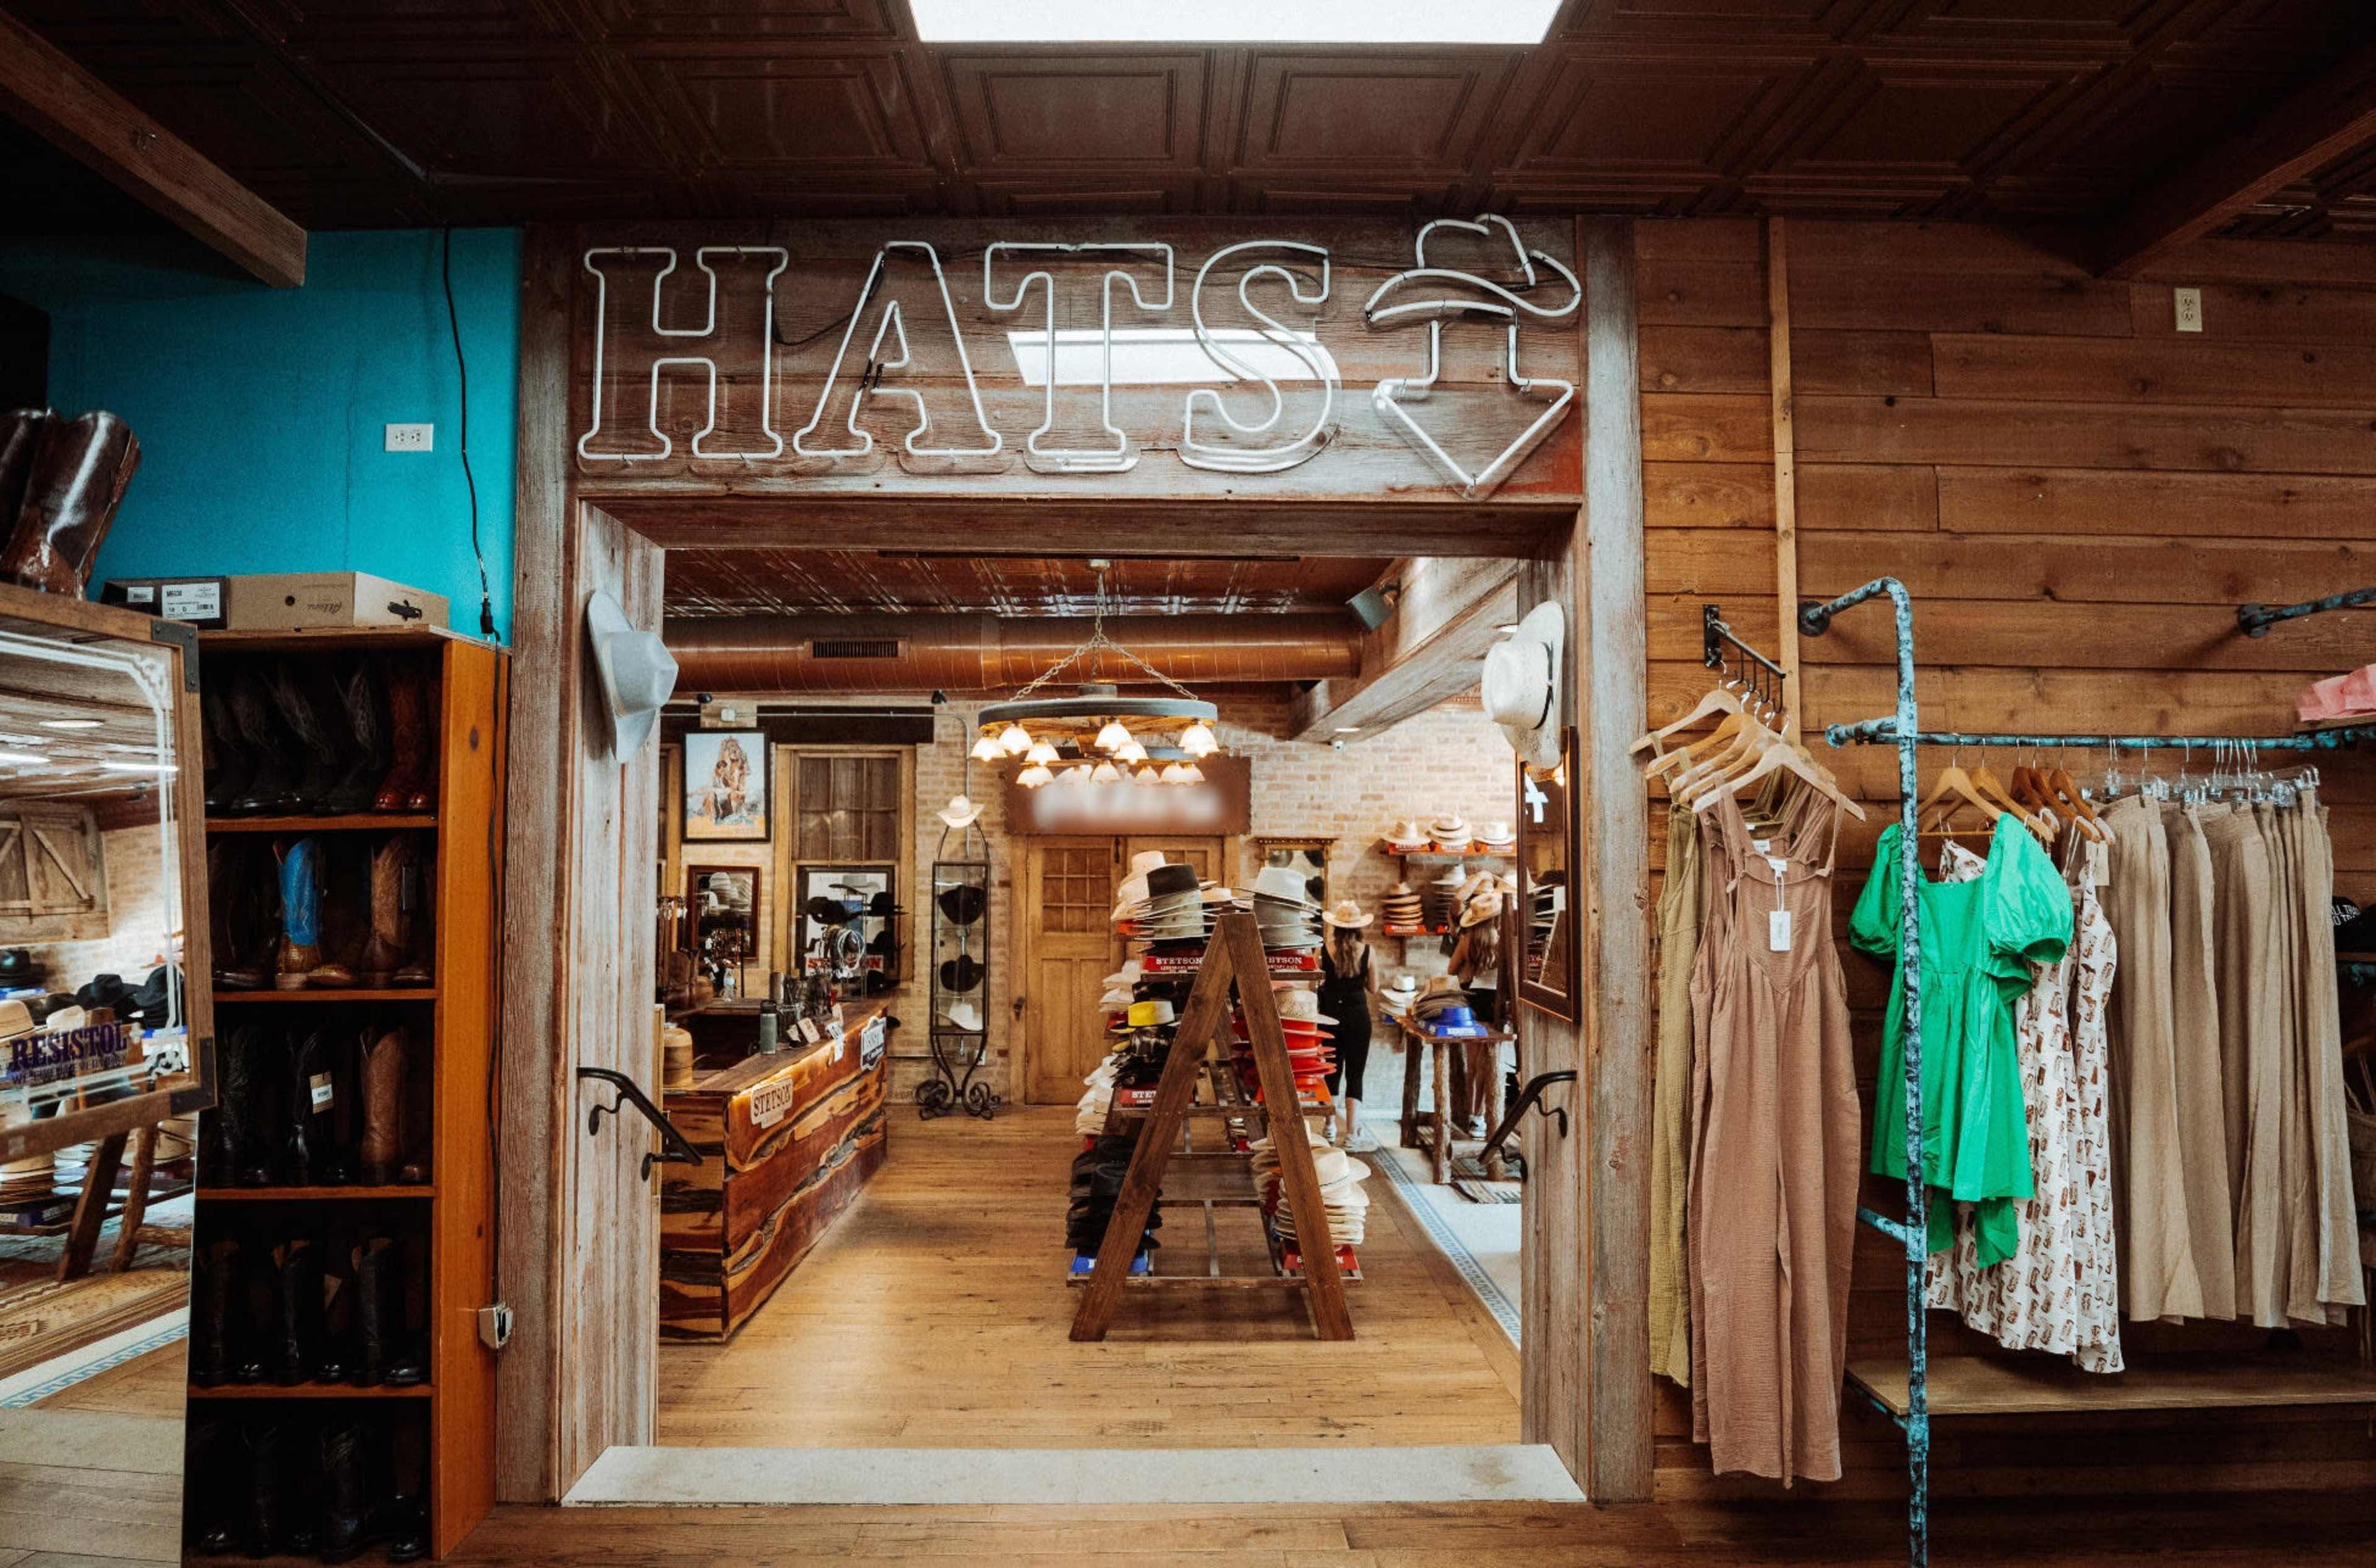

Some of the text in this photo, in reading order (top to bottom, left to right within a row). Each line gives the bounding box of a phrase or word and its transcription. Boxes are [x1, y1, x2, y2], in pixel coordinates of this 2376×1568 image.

[577, 240, 1335, 469] HATS
[1156, 957, 1203, 965] STETSON
[9, 1022, 127, 1072] RESISTOL
[754, 1083, 791, 1117] STETSON
